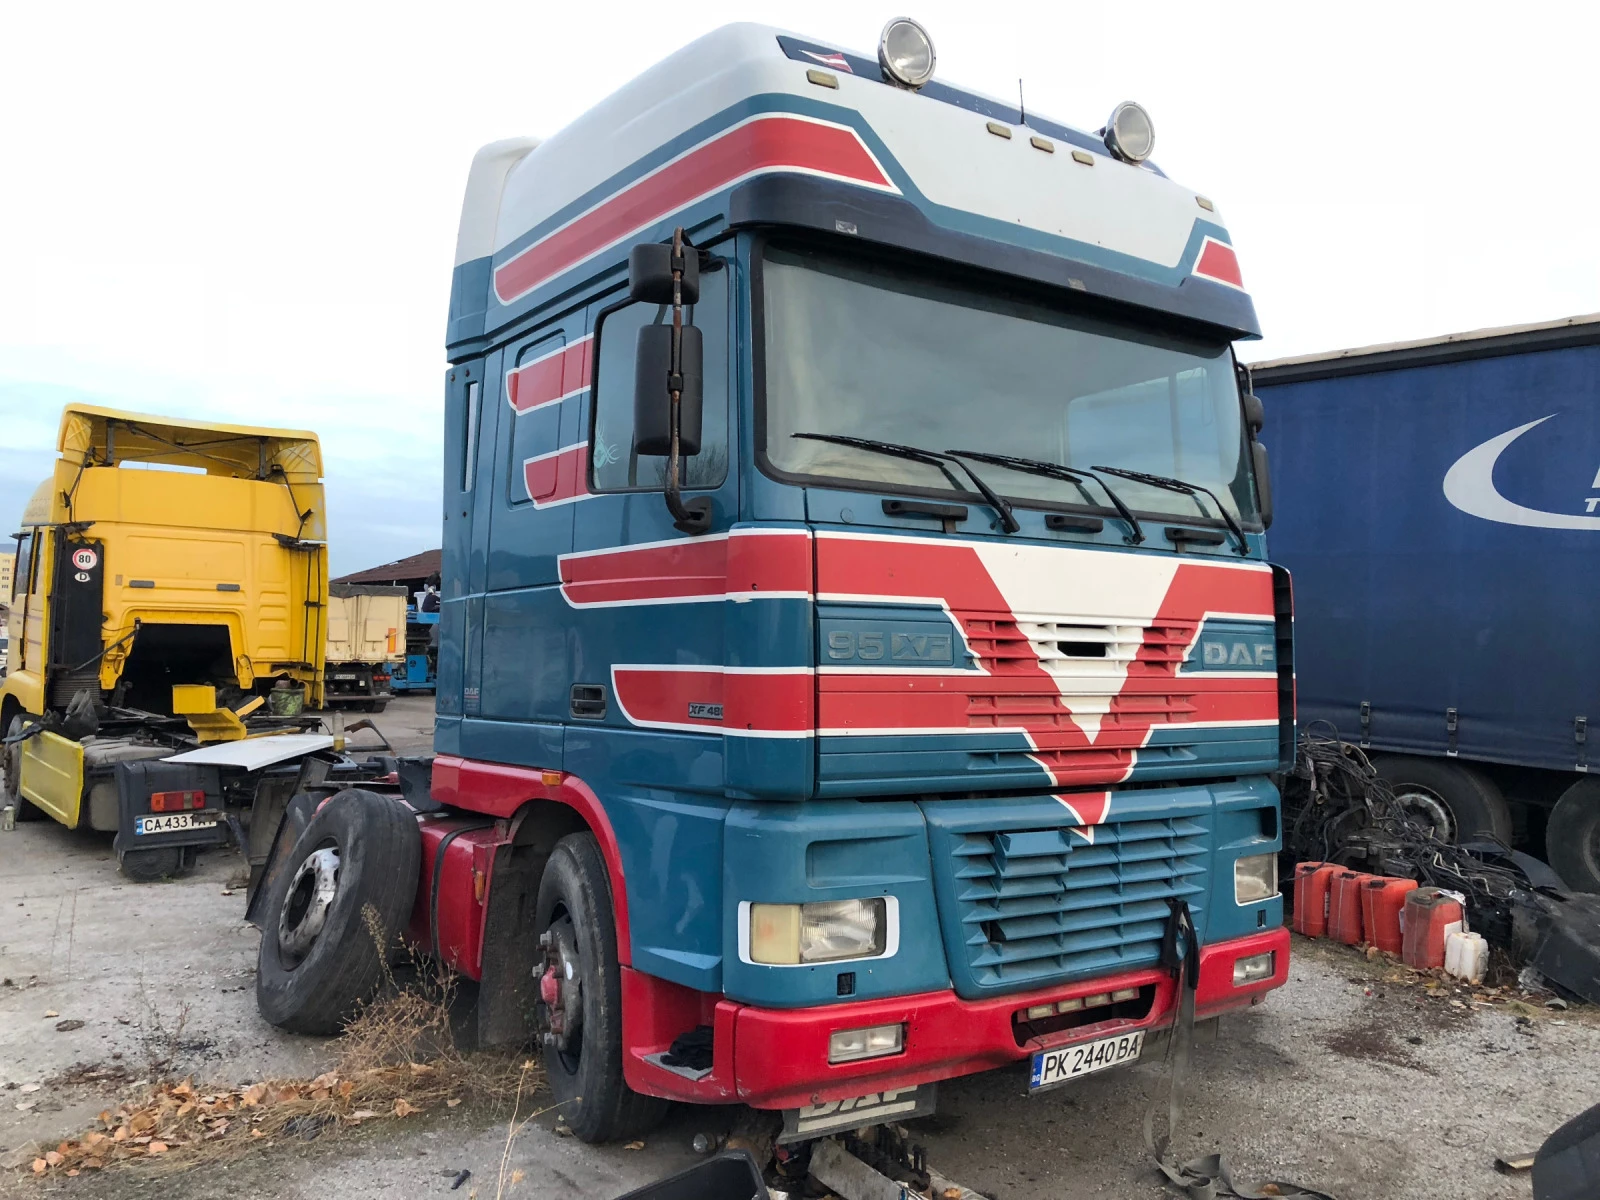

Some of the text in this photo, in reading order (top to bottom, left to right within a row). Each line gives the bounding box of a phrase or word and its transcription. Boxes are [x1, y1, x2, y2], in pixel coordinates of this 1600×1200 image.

[79, 555, 91, 563] 80
[828, 630, 951, 661] 95 XF
[1203, 641, 1274, 665] DAF
[464, 687, 479, 695] DAF
[690, 704, 705, 715] XF
[144, 819, 161, 832] CA
[165, 815, 195, 829] 4331
[1043, 1034, 1140, 1081] PK 2440 BA
